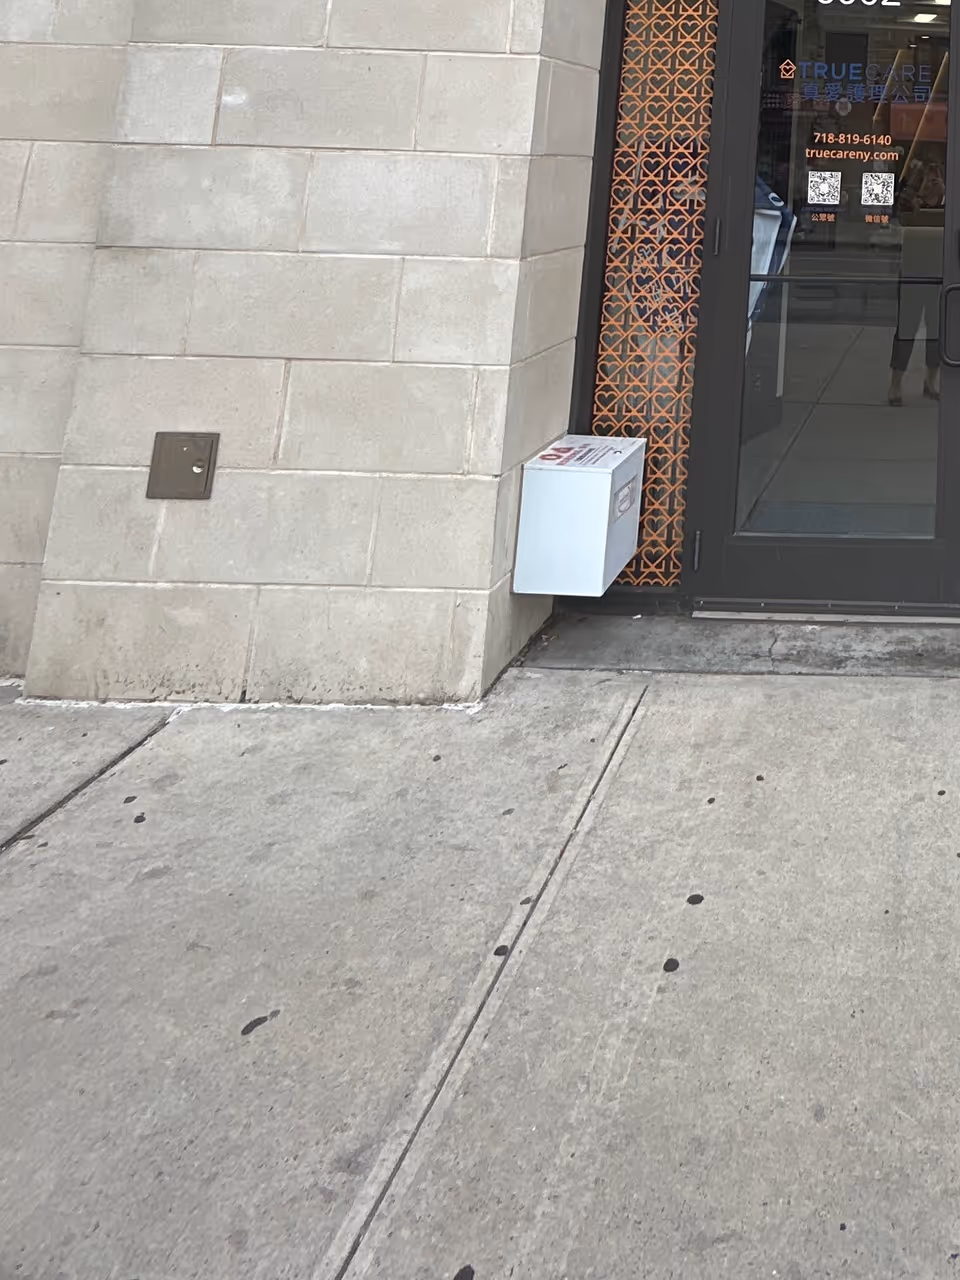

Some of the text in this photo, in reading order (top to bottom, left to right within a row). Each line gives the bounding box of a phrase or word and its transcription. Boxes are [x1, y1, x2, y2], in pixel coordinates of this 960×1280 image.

[798, 61, 931, 82] TRUECARE
[801, 82, 932, 104] 真愛護理公司
[814, 132, 892, 146] 718-819-6140
[805, 148, 899, 162] truecareny.com
